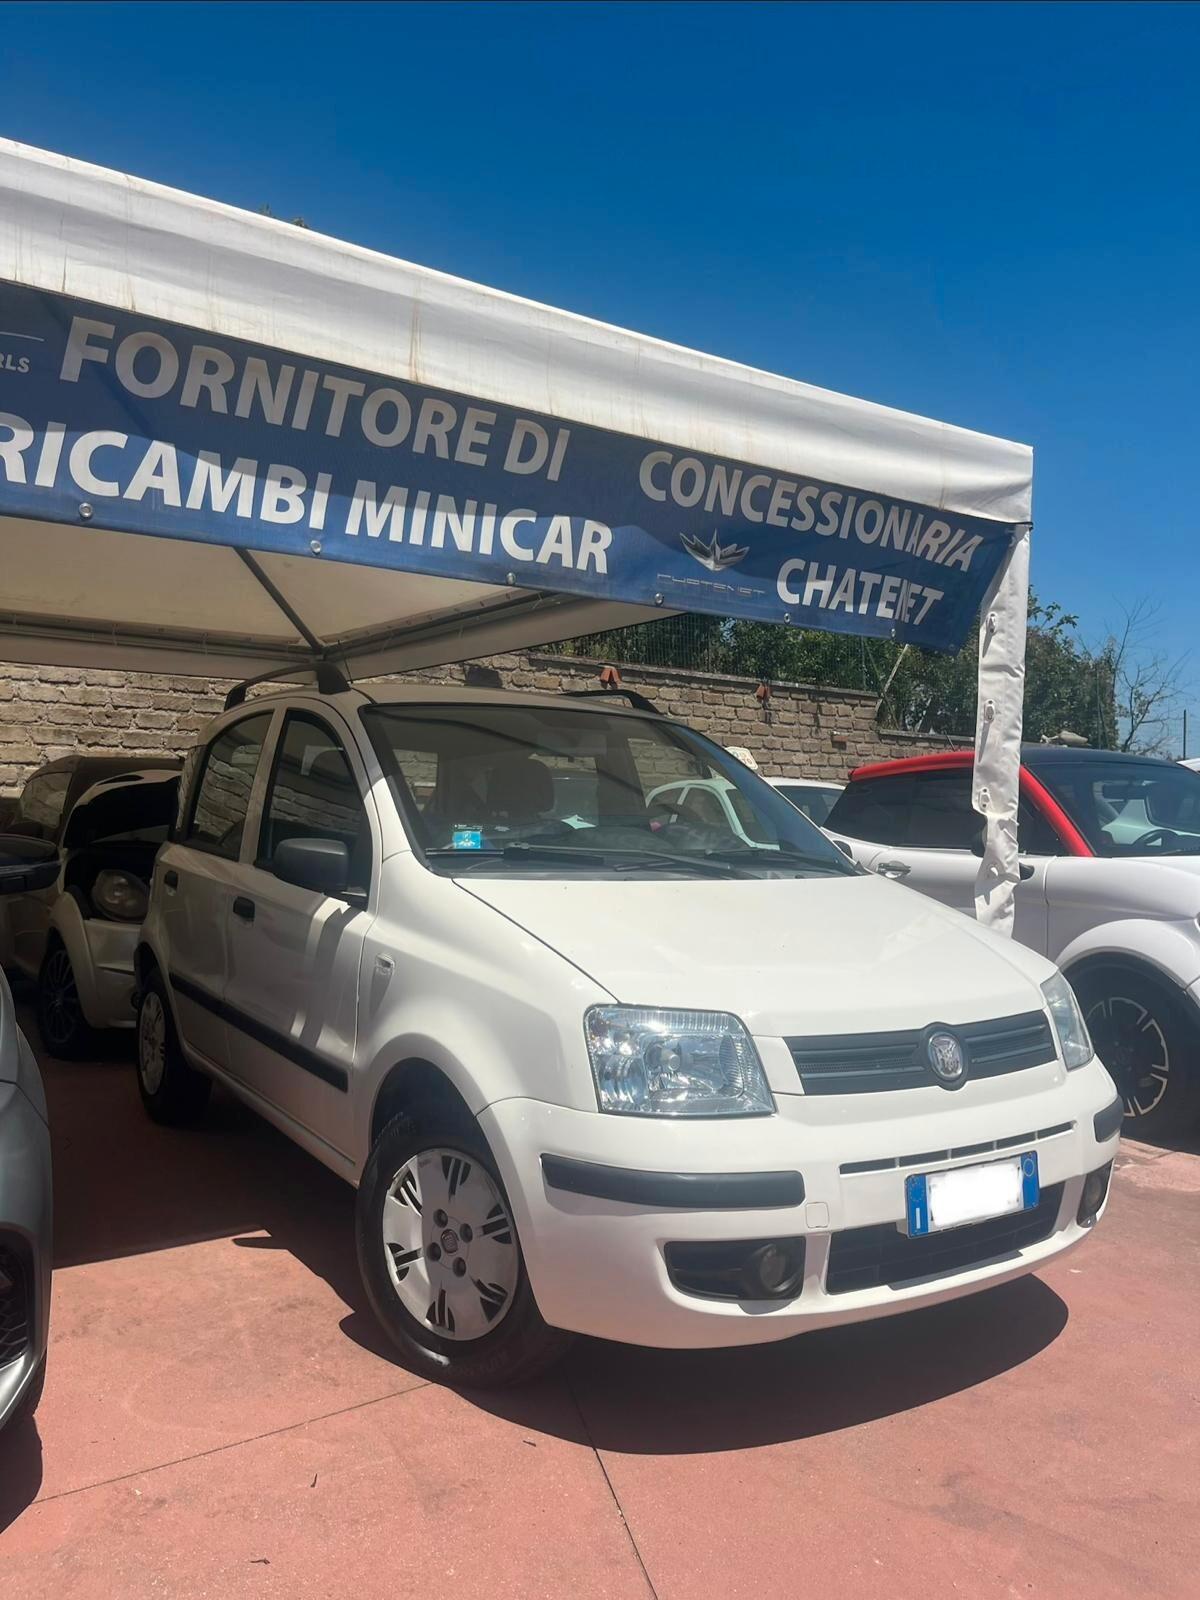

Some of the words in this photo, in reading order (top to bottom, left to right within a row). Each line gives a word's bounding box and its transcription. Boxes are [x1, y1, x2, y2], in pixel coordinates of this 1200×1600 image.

[59, 315, 497, 467] FORNITORE
[503, 418, 571, 482] DI
[0, 411, 333, 531] RICAMBI
[345, 479, 614, 575] MINICAR
[639, 450, 985, 573] CONCESSIONARIA
